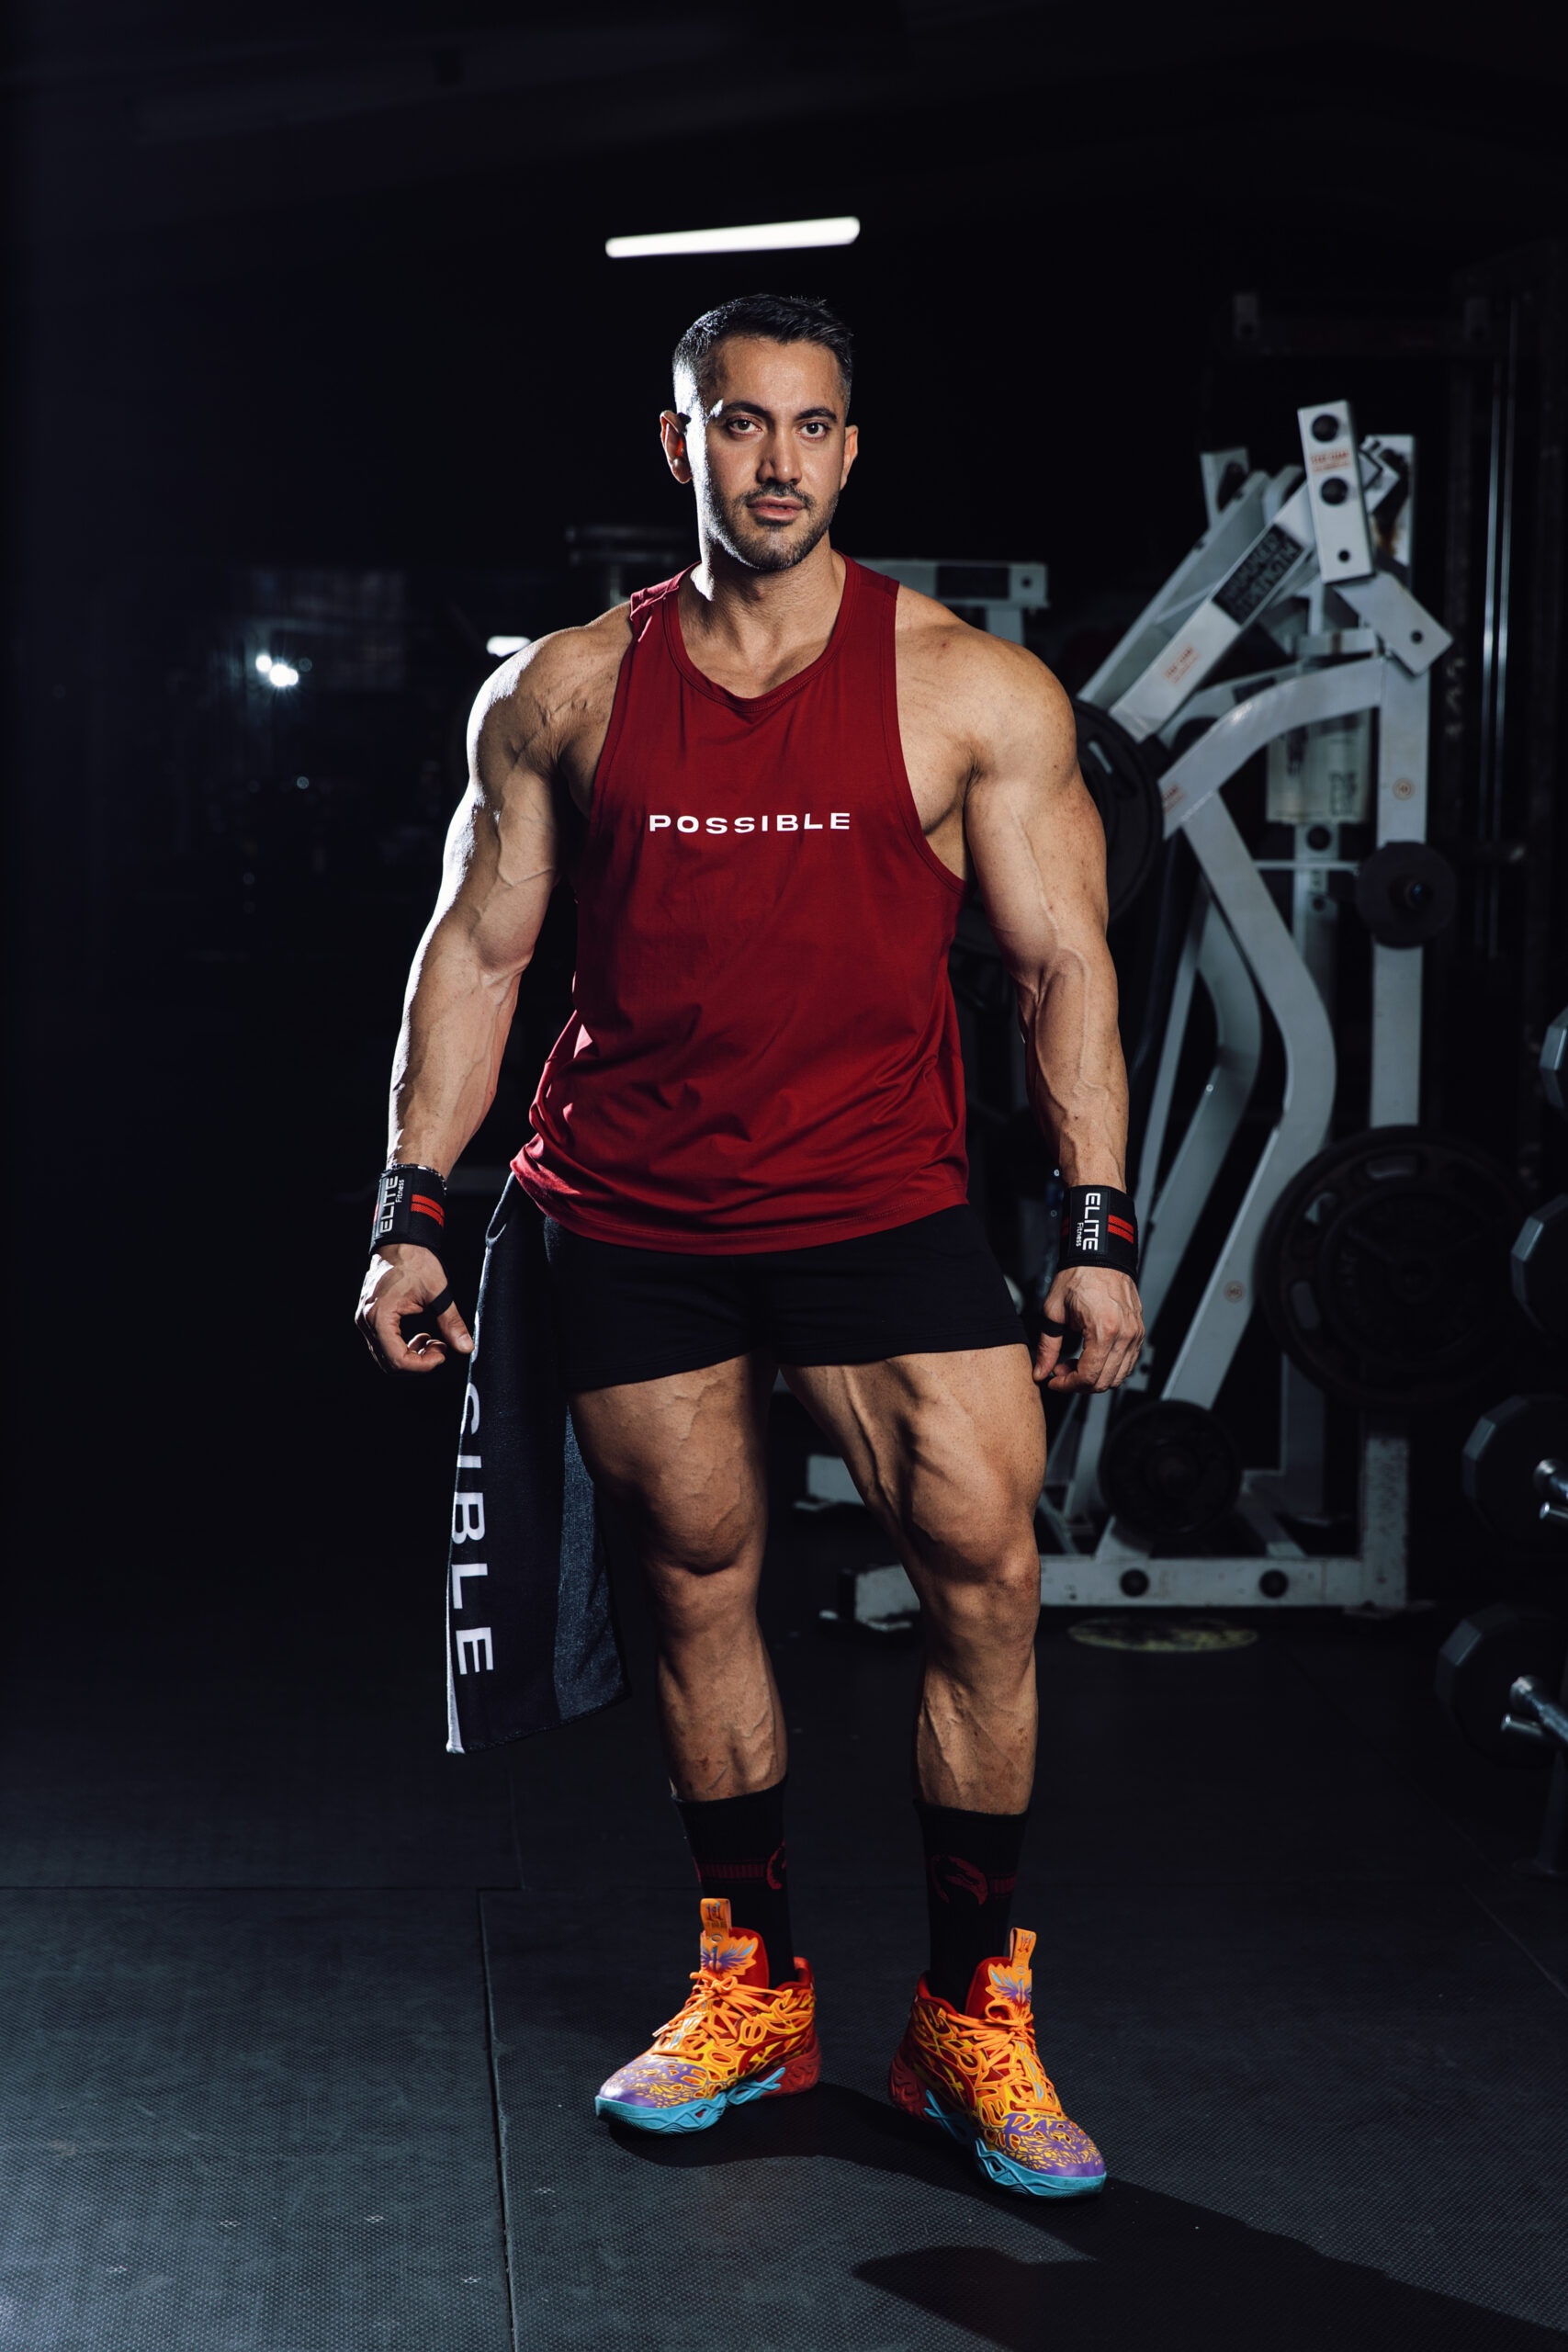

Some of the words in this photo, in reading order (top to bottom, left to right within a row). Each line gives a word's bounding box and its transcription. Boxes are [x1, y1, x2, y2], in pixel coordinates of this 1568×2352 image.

[649, 812, 851, 834] POSSIBLE
[379, 1175, 399, 1233] ELITE
[395, 1179, 405, 1204] Fitness
[1075, 1221, 1085, 1248] Fitness
[1082, 1193, 1101, 1251] ELITE
